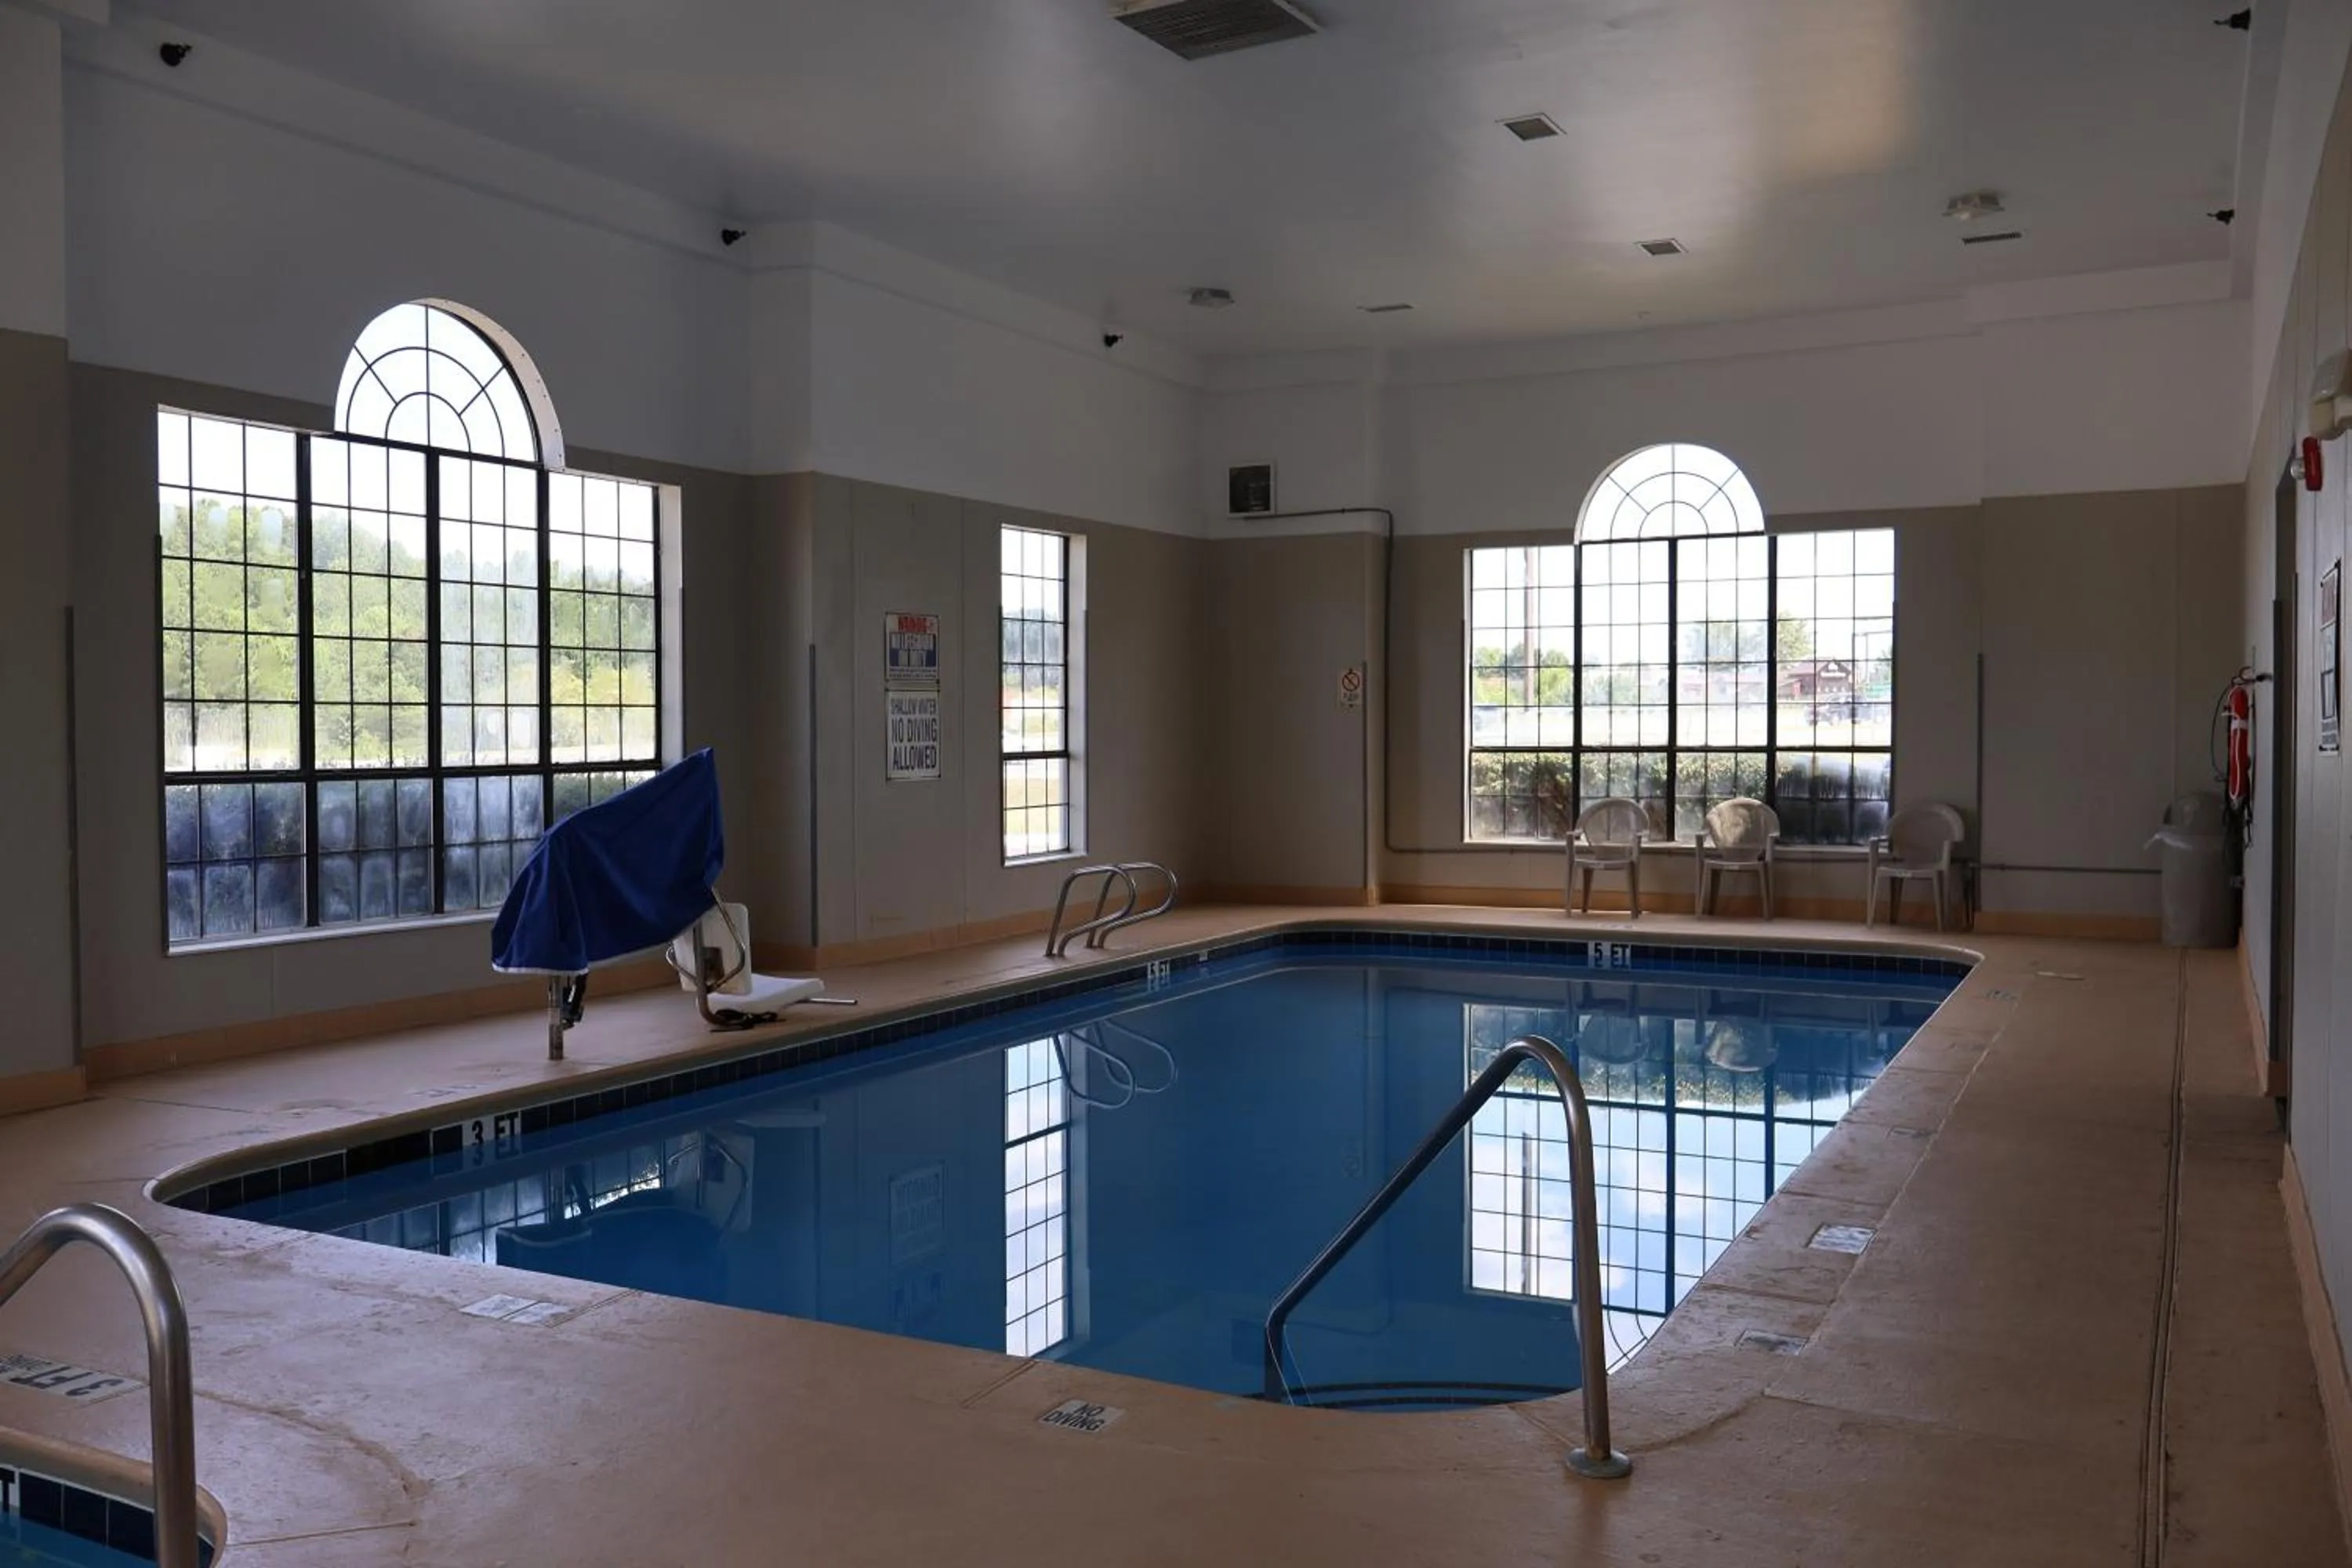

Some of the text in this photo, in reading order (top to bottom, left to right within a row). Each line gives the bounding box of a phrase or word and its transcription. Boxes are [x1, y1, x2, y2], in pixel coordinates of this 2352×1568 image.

[891, 717, 938, 743] NO DIVING
[892, 745, 938, 771] ALLOWED
[472, 1111, 520, 1145] 3 FT
[1042, 1410, 1105, 1432] DIVING
[1073, 1403, 1105, 1417] NO
